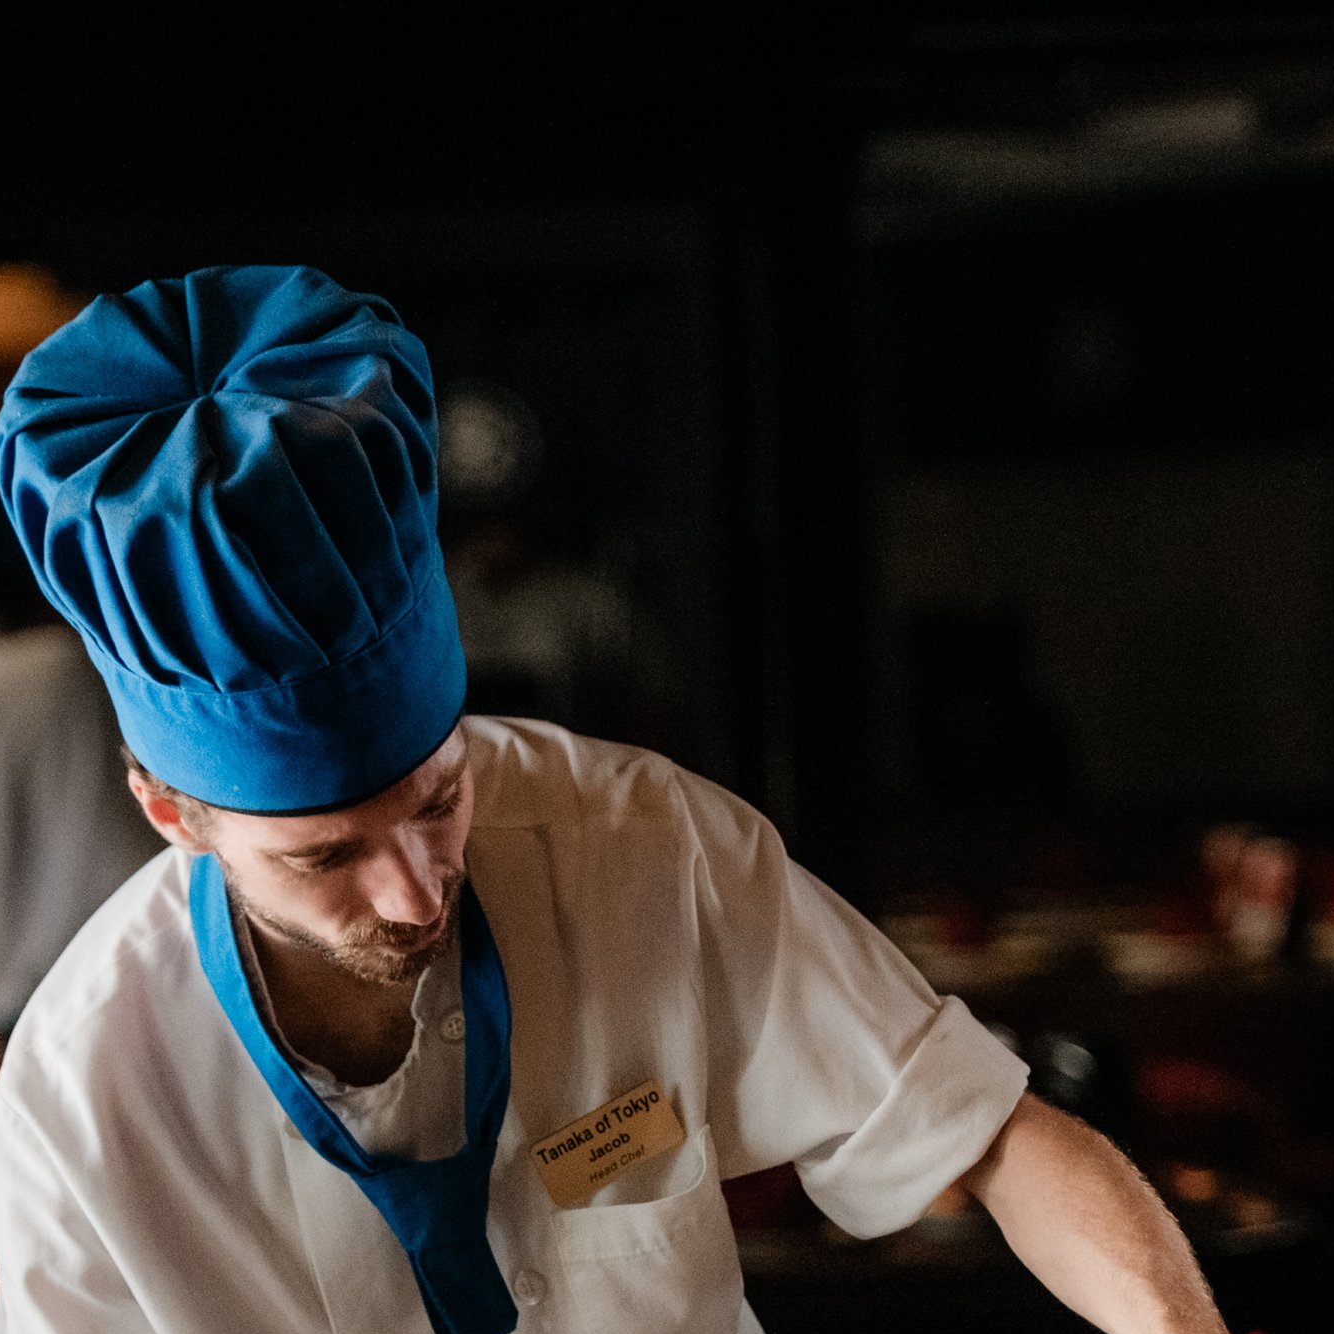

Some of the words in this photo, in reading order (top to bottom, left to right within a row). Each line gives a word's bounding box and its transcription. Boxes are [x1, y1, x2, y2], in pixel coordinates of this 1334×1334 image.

[536, 1128, 593, 1165] Tanaka
[595, 1113, 612, 1134] of
[611, 1090, 660, 1123] Tokyo
[588, 1132, 631, 1163] Jacob
[589, 1161, 618, 1183] Head
[619, 1144, 646, 1166] Chef
